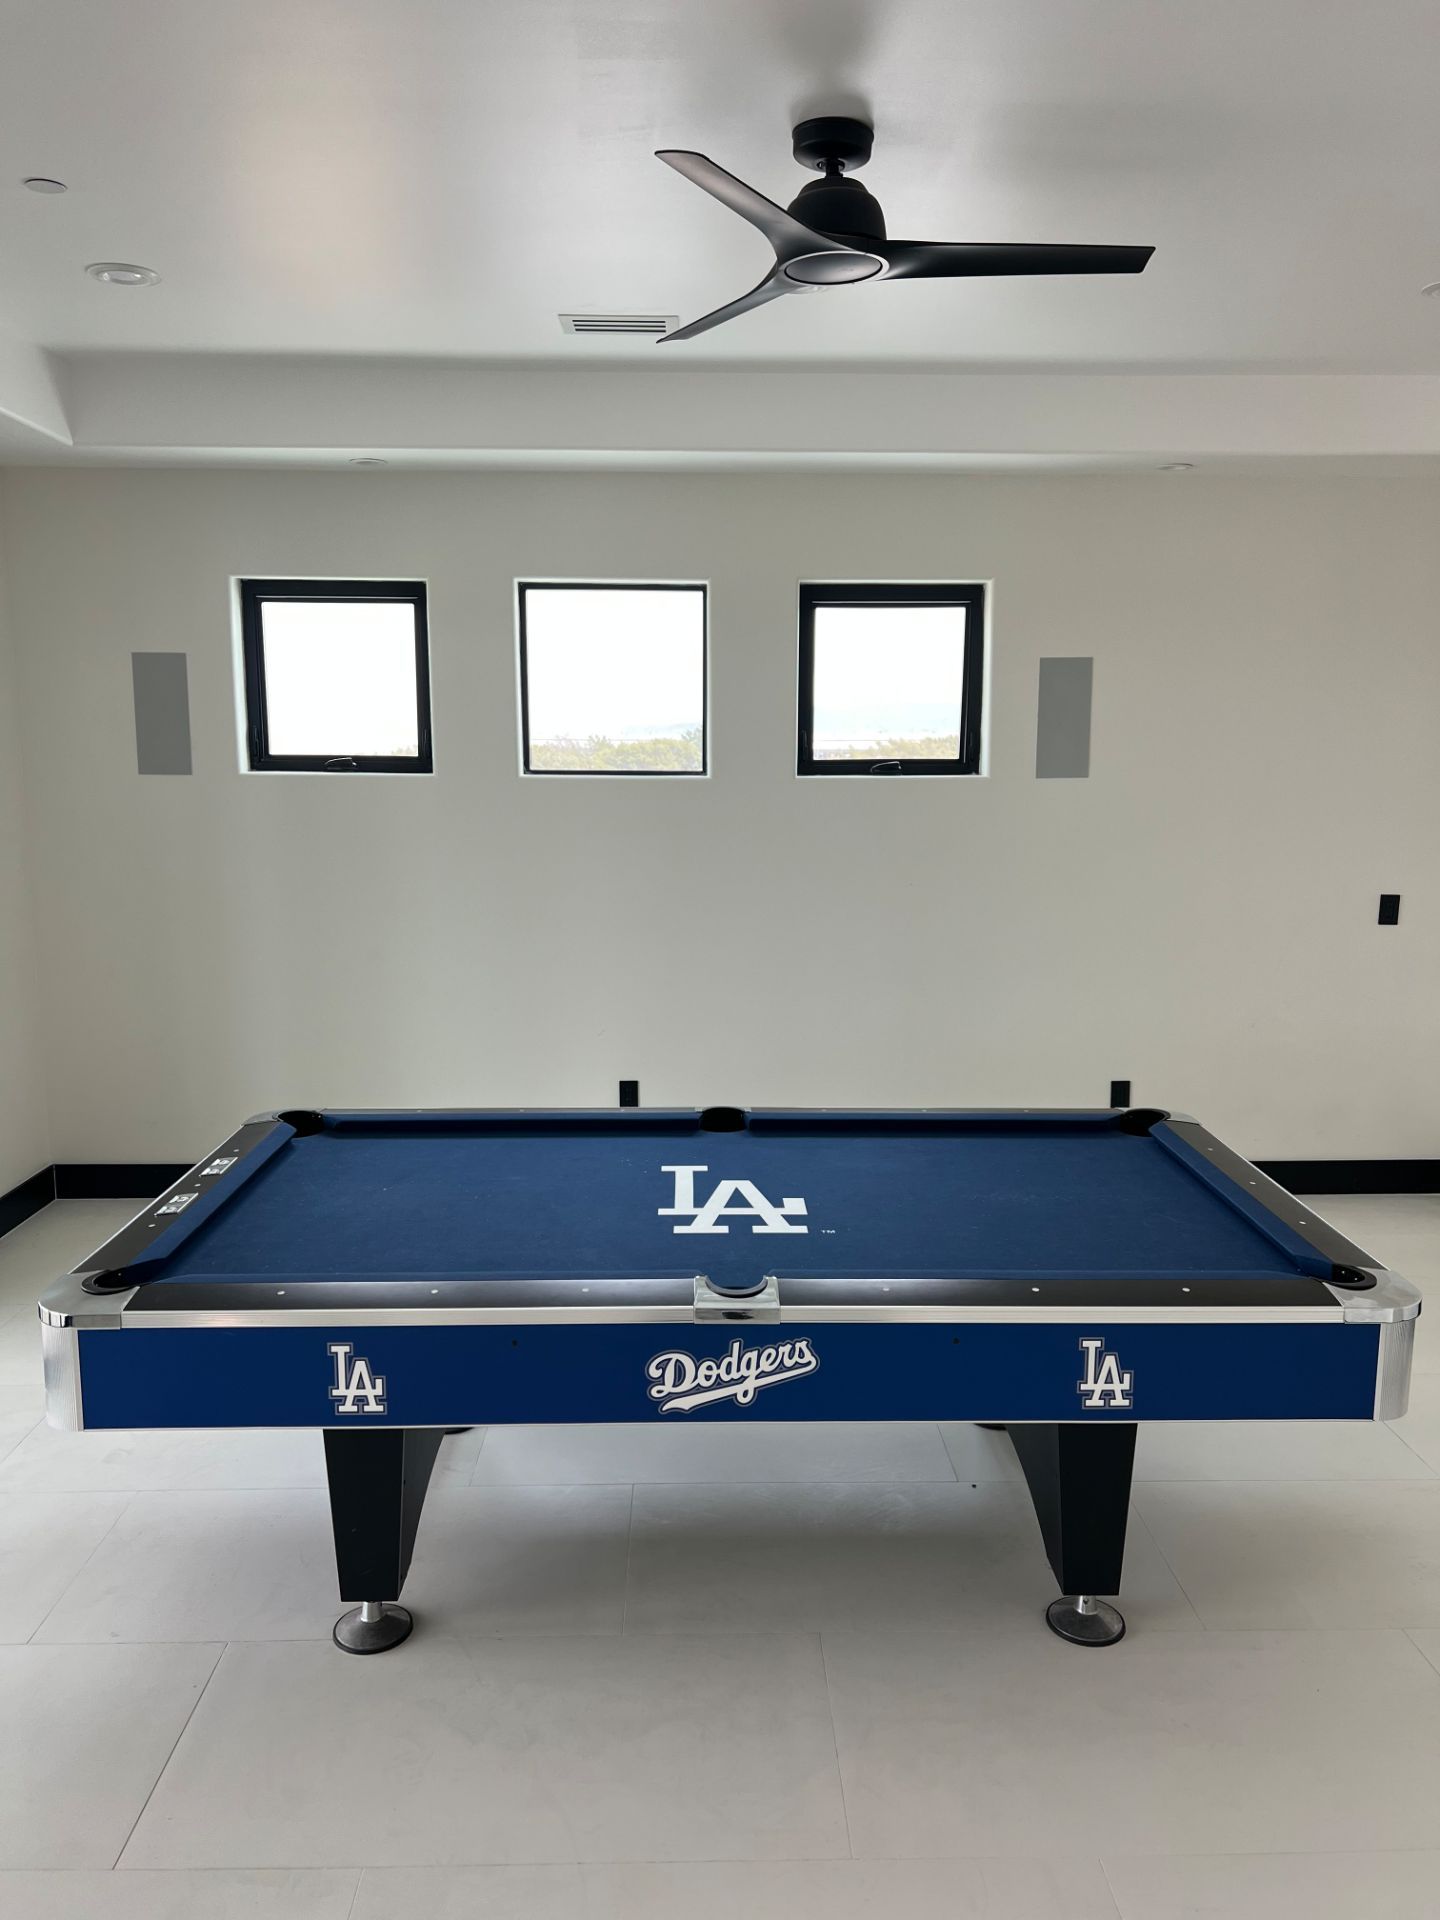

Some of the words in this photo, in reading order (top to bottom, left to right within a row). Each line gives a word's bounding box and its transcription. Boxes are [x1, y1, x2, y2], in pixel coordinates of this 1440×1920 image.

[657, 1165, 808, 1234] LA
[328, 1343, 386, 1414] LA
[647, 1338, 819, 1412] Dodgers
[1078, 1338, 1132, 1408] LA
